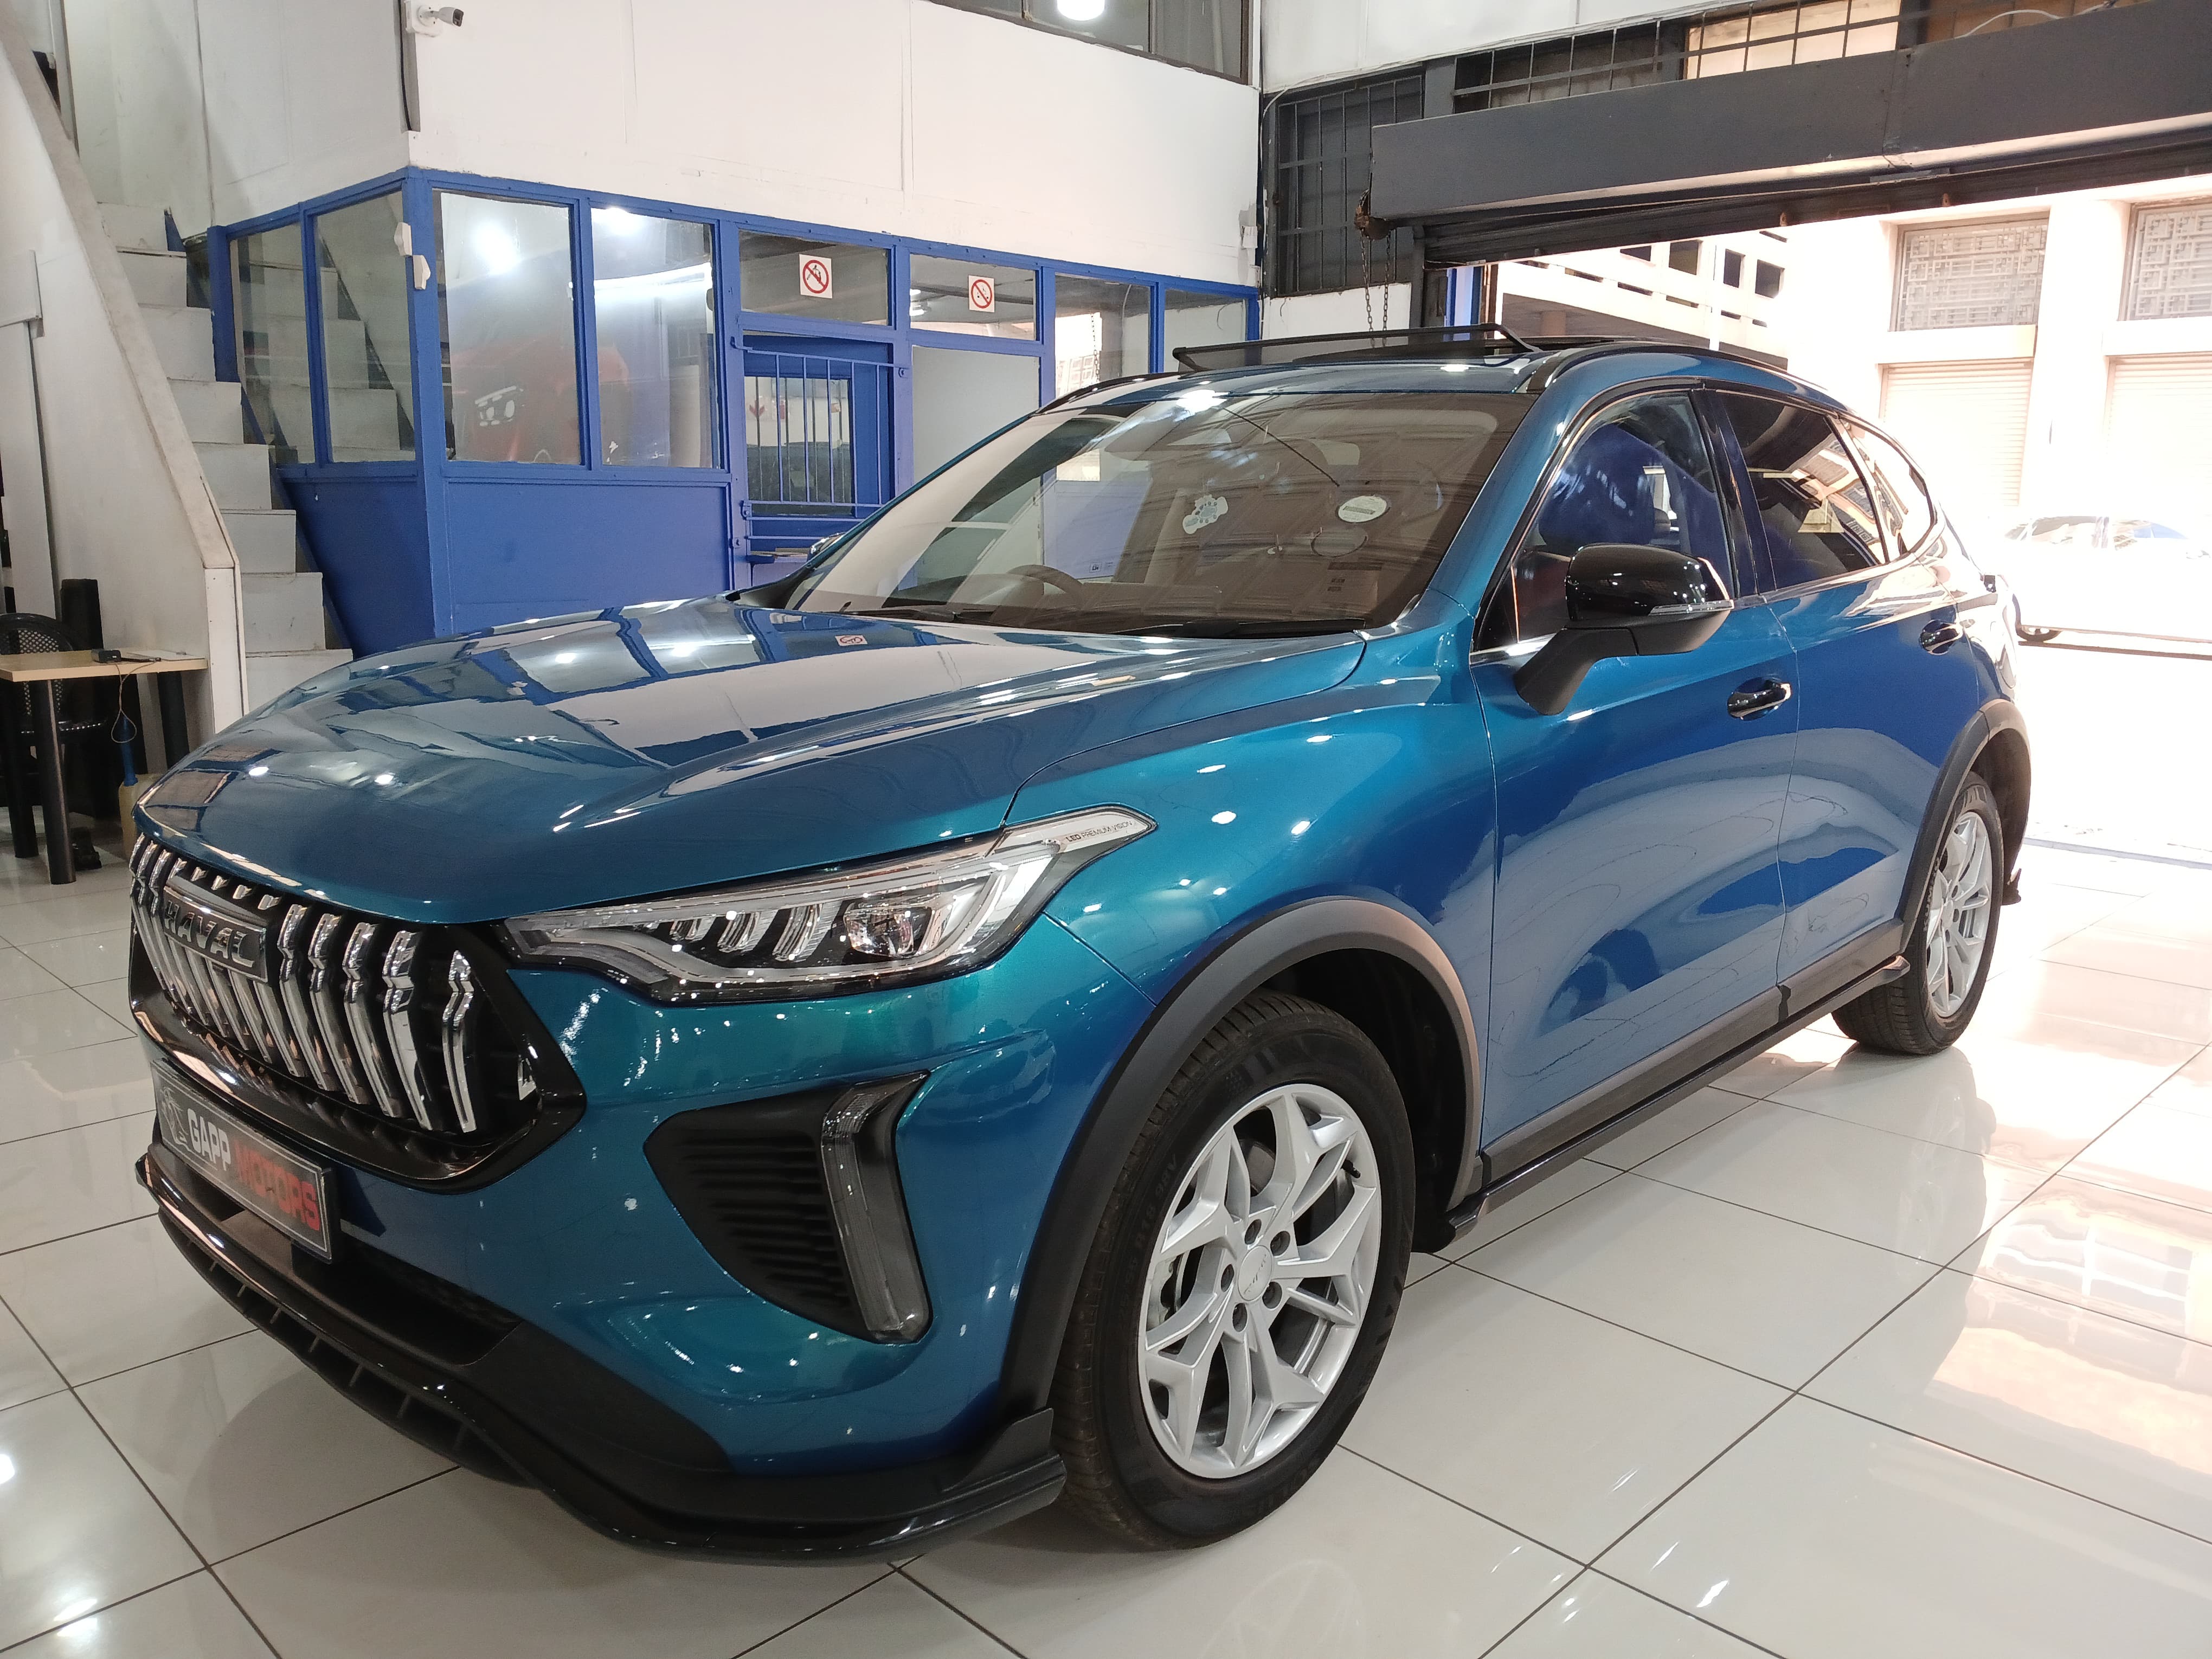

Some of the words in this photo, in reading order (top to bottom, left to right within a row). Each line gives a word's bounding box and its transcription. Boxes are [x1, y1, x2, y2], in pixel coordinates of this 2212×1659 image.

[1065, 834, 1082, 842] LED
[1082, 826, 1112, 838] PREMIUM
[164, 900, 255, 968] HAVAL
[188, 1108, 231, 1172] GAPP
[234, 1140, 320, 1231] MOTORS
